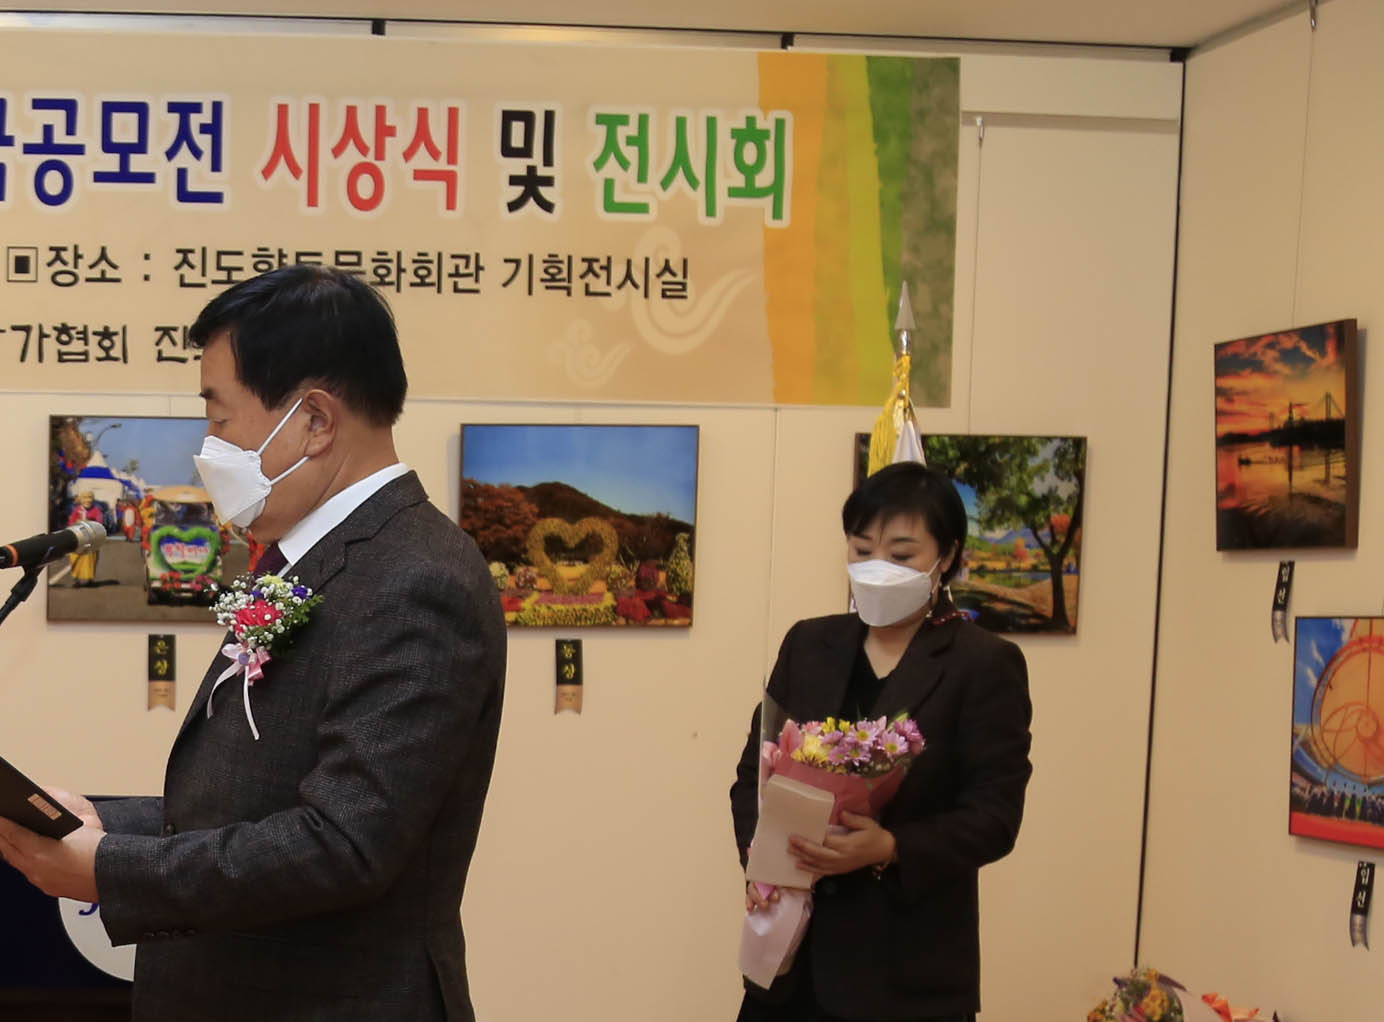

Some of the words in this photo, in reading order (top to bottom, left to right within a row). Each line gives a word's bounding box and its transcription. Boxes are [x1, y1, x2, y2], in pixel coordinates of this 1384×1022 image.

[260, 102, 461, 213] 시상식
[499, 108, 557, 215] 및
[593, 112, 787, 220] 전시회
[45, 244, 123, 288] 장소
[500, 253, 689, 301] 기획전시실
[154, 325, 202, 364] 진
